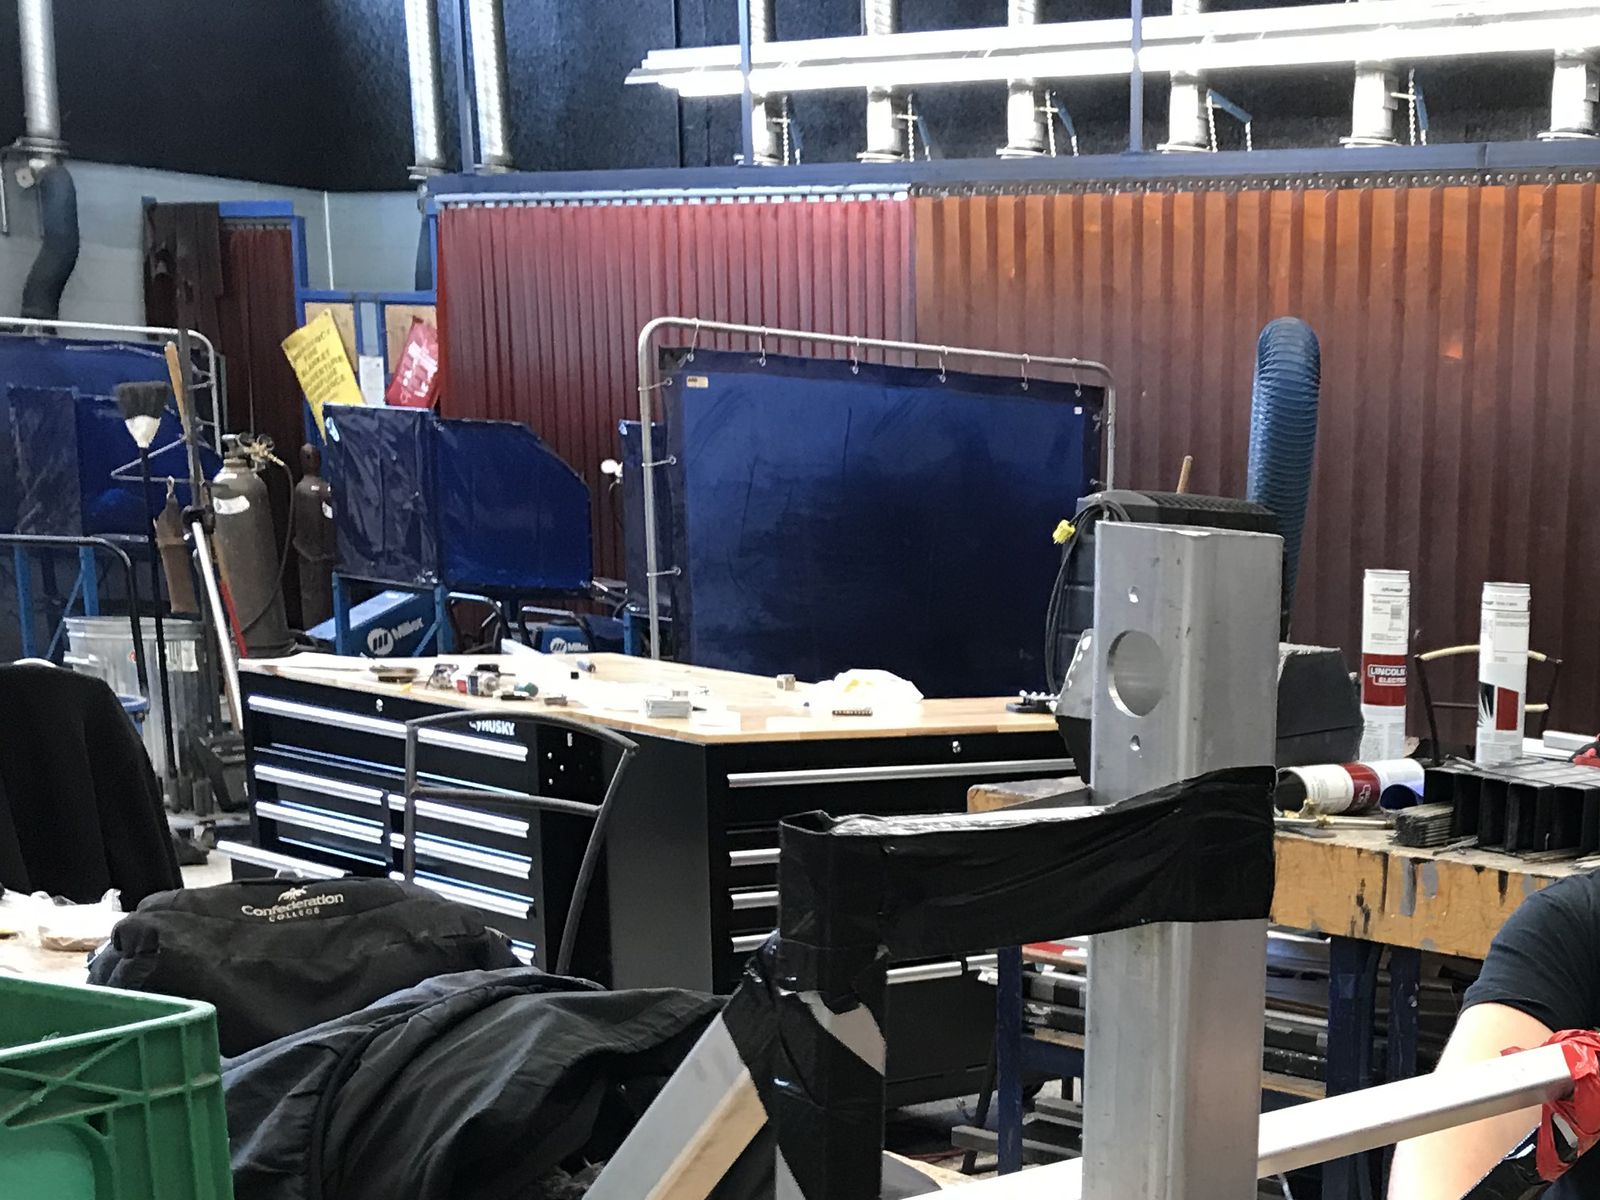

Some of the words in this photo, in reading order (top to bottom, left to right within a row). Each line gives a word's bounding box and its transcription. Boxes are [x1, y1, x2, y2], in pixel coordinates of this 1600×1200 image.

[391, 617, 424, 641] Miller
[481, 720, 515, 735] HUSKY
[241, 893, 344, 917] Confederation
[268, 907, 320, 922] COLLEGE
